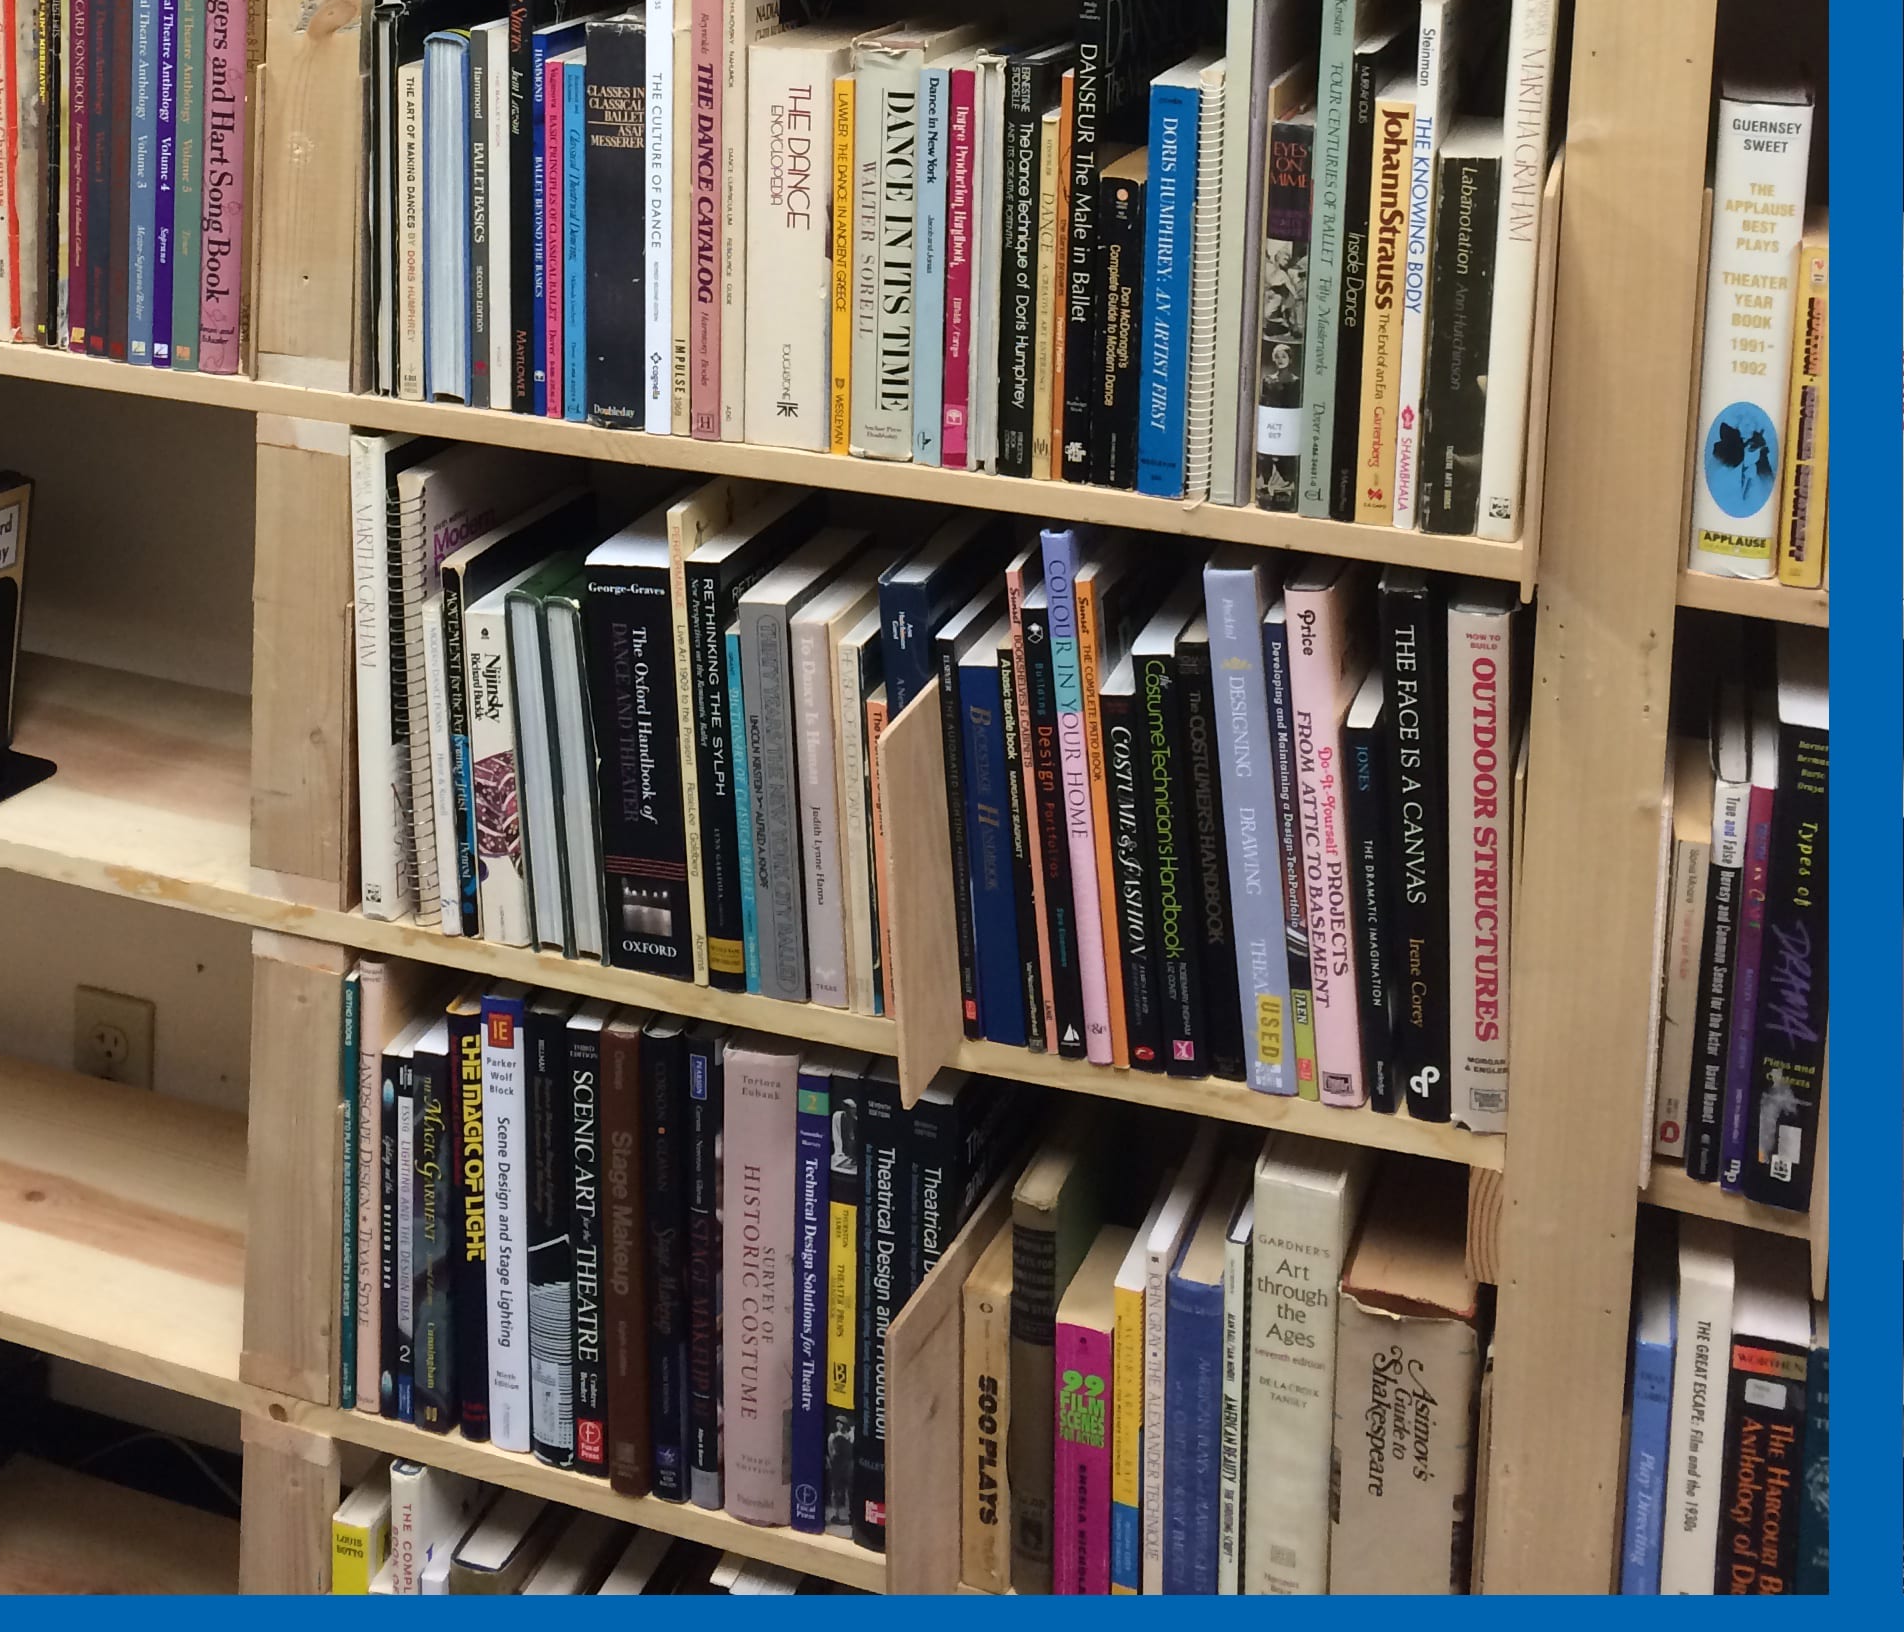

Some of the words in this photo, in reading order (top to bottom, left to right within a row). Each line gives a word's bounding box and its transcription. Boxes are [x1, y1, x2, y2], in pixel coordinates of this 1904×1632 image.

[697, 64, 714, 110] THE
[1733, 119, 1801, 136] GUERNSEY
[697, 113, 714, 192] DANCE
[885, 91, 914, 202] DANCE
[1744, 138, 1788, 153] SWEET
[884, 215, 913, 250] IN
[696, 196, 715, 304] CATALOG
[883, 260, 912, 314] ITS
[881, 325, 911, 411] TIME
[588, 582, 665, 596] George-Graves
[1296, 610, 1314, 656] Price
[1396, 625, 1416, 672] THE
[1398, 681, 1418, 741] FACE
[1472, 657, 1498, 819] OUTDOOR
[1400, 747, 1420, 767] IS
[1402, 775, 1422, 792] A
[1403, 802, 1426, 904] CANVAS
[623, 940, 678, 957] OXFORD
[1474, 826, 1500, 1043] STRUCTURES
[486, 1057, 516, 1070] Parker
[490, 1072, 512, 1082] Wolf
[489, 1085, 514, 1095] Block
[1275, 1259, 1310, 1285] Art
[1257, 1278, 1327, 1309] through
[1277, 1303, 1306, 1323] the
[1265, 1321, 1316, 1349] Ages
